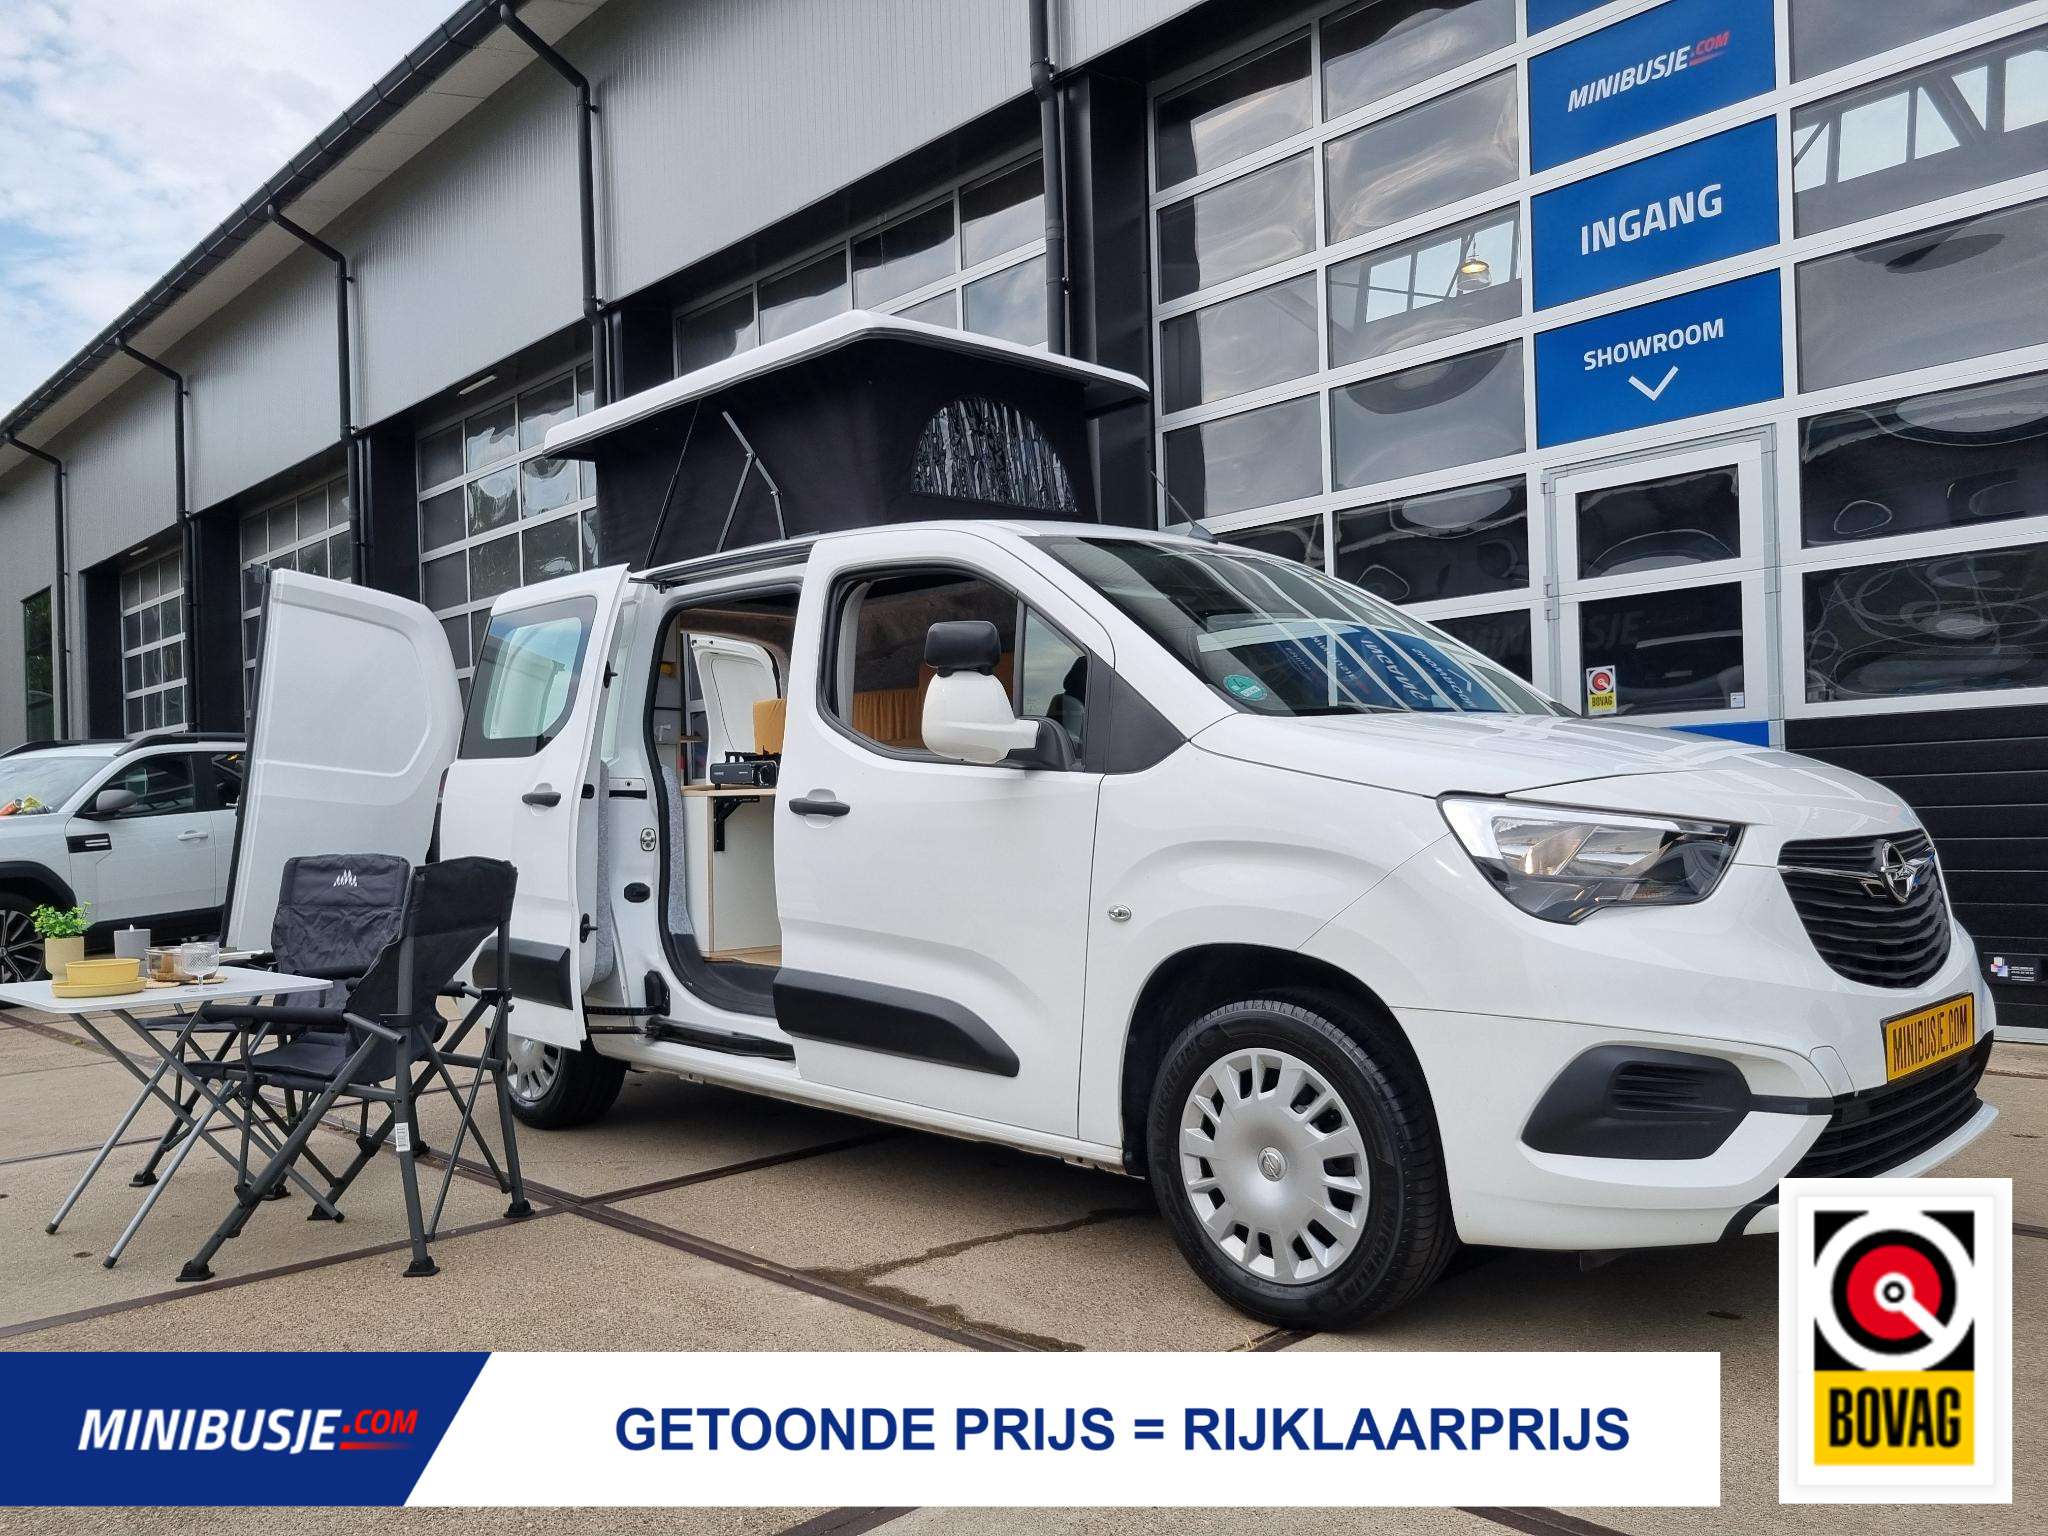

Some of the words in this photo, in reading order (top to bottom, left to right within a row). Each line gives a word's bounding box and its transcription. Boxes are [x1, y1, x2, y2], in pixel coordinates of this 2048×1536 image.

[1581, 184, 1722, 256] INGANG
[1584, 318, 1724, 371] SHOWROOM
[1591, 695, 1613, 707] BOVAG
[1893, 1004, 1968, 1072] MINIBUSJE.COM
